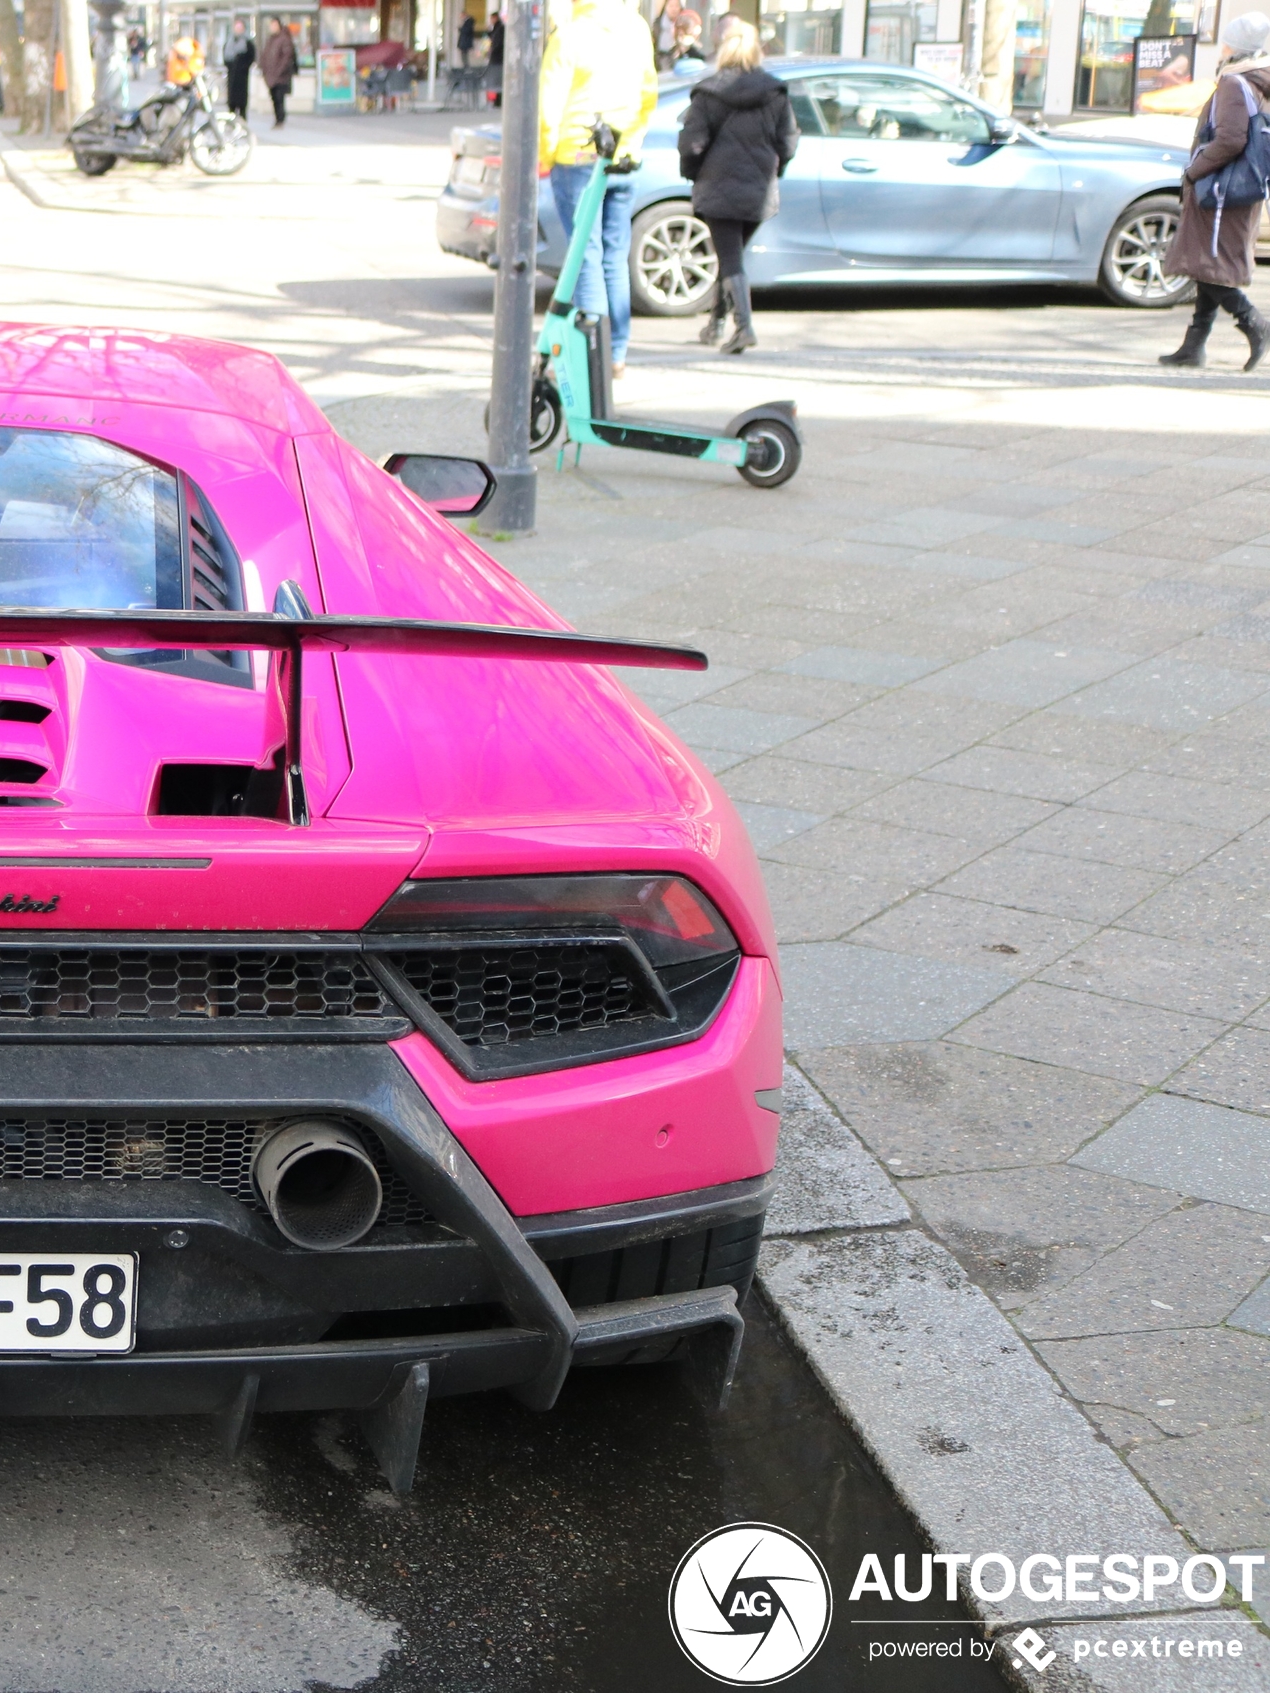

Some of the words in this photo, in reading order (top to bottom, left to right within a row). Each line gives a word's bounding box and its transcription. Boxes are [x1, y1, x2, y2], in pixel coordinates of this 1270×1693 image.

[1139, 39, 1171, 51] DON'T
[1139, 50, 1163, 60] MISS
[1164, 50, 1171, 59] A
[1139, 59, 1164, 69] BEAT
[558, 364, 574, 407] TIER
